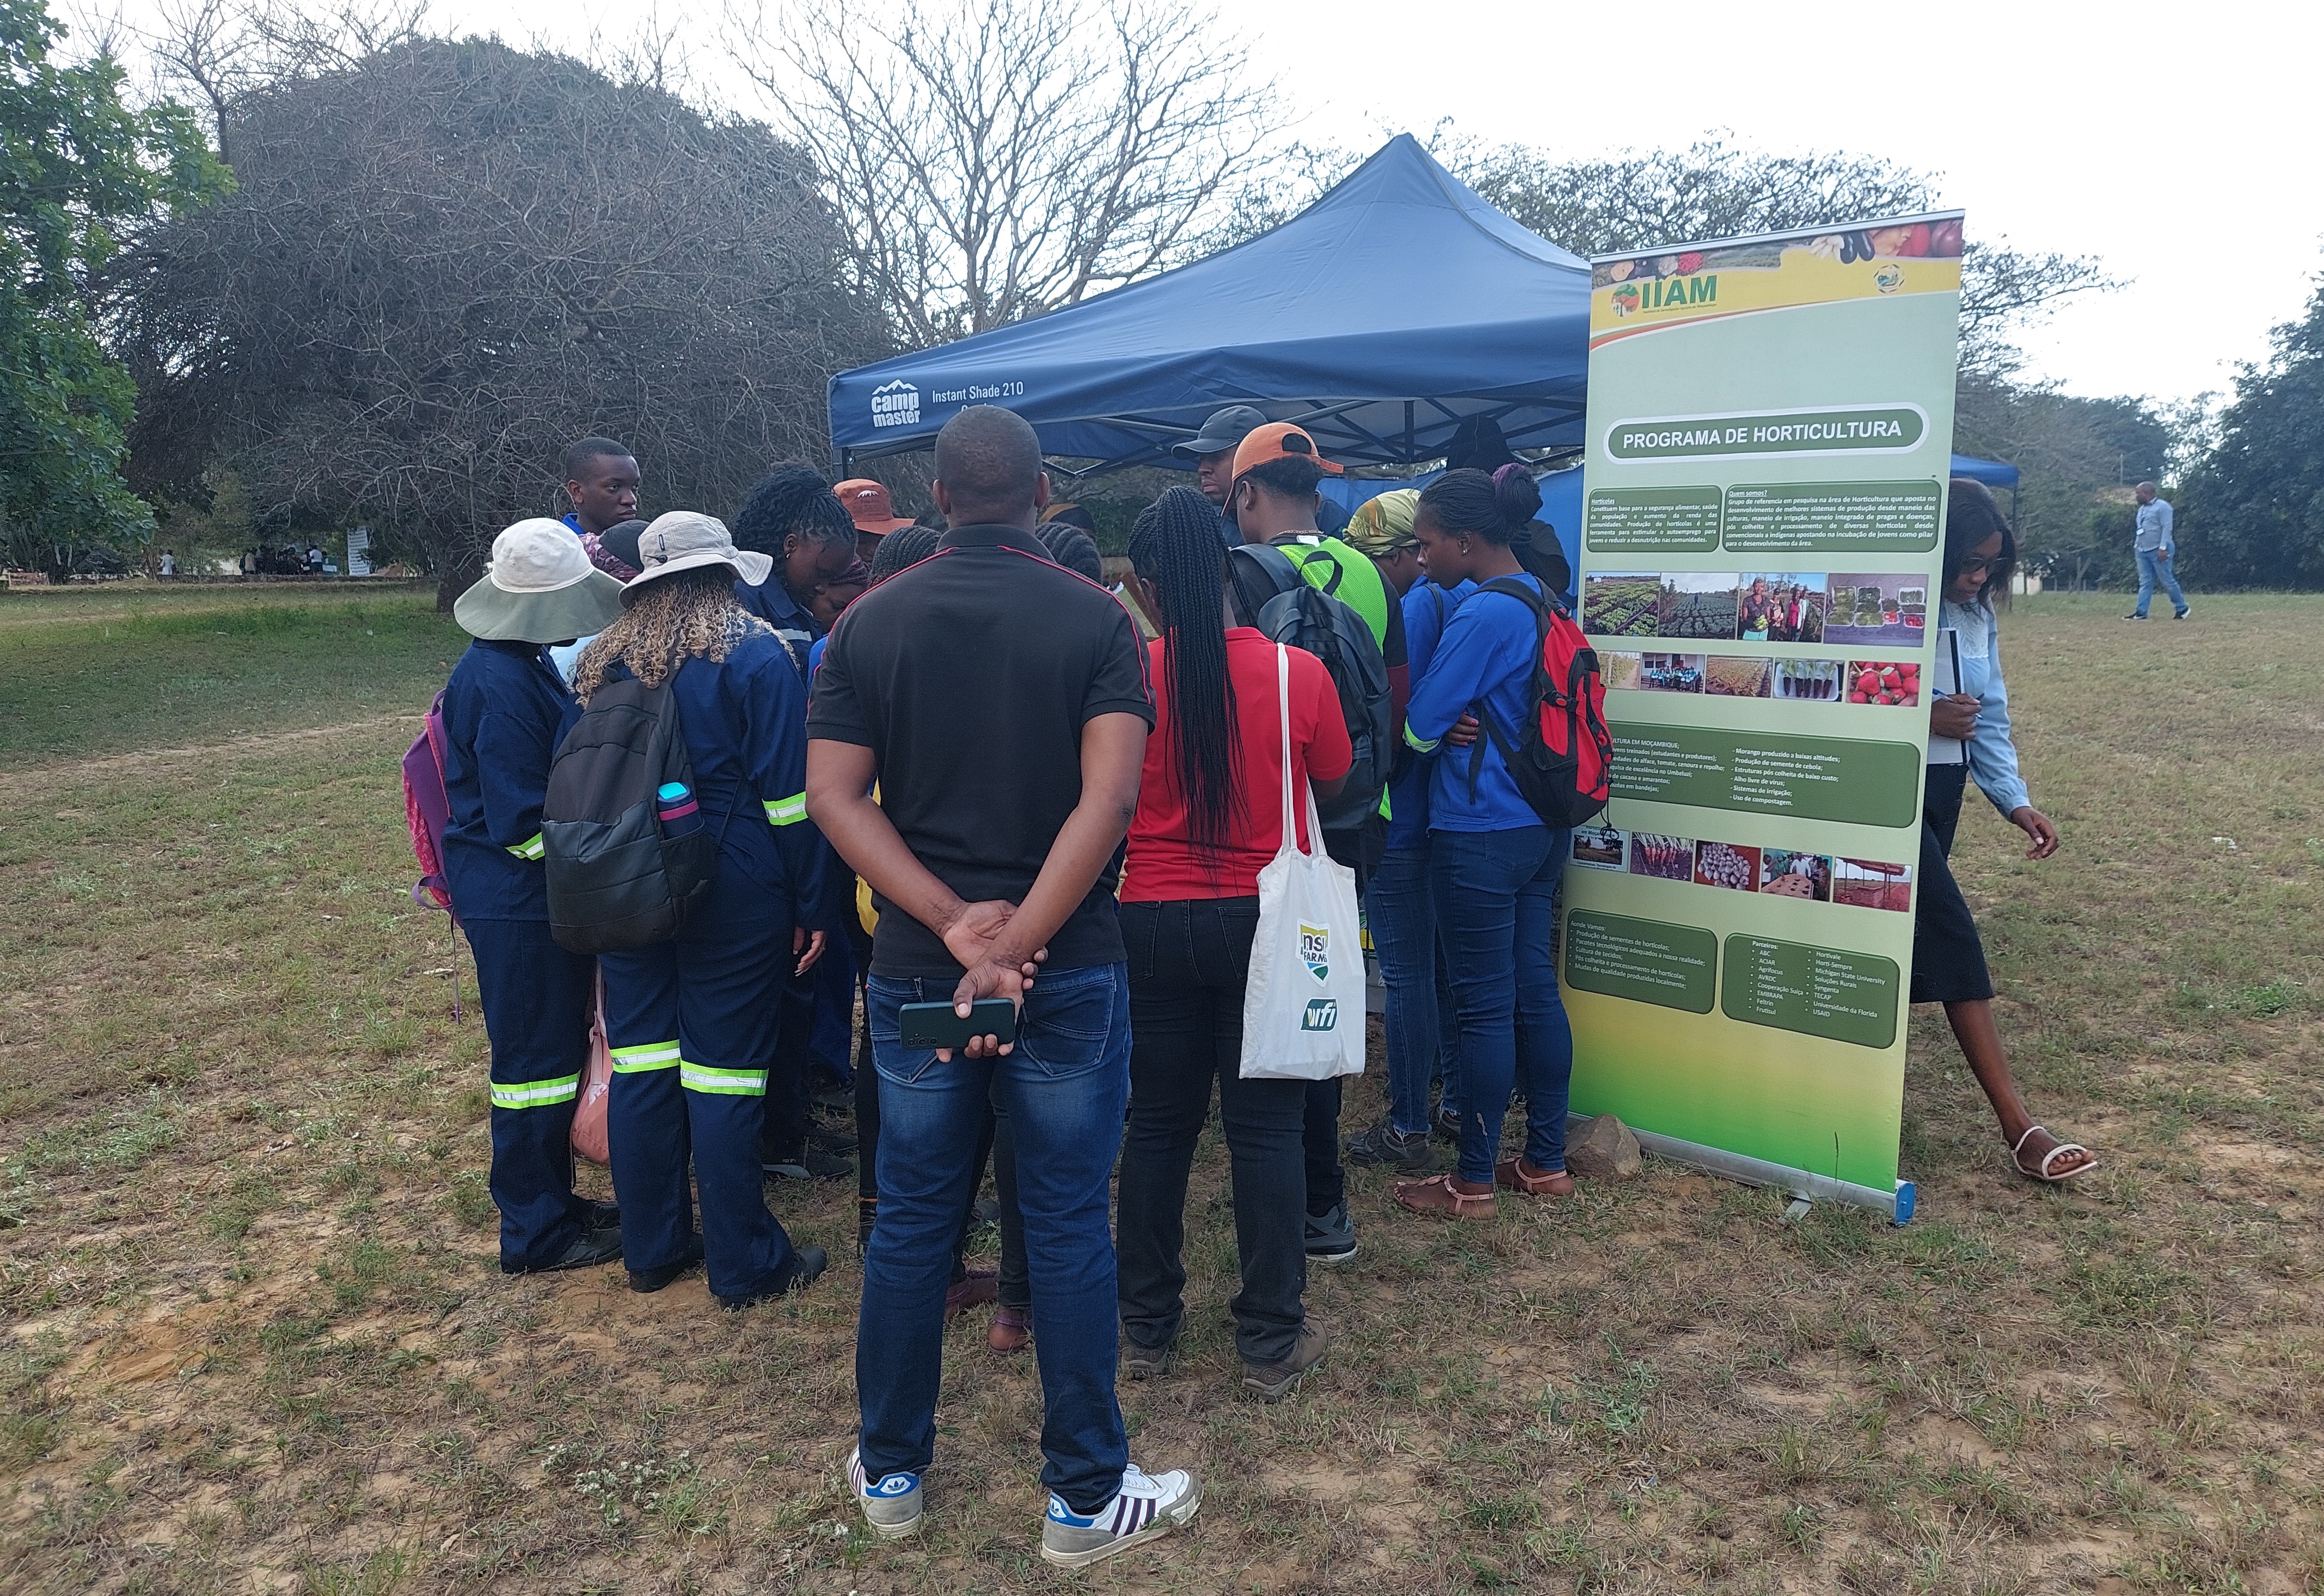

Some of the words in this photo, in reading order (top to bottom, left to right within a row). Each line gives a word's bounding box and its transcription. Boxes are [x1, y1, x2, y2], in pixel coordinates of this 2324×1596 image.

[1642, 275, 1717, 309] IIAM
[933, 388, 967, 403] Instant
[969, 384, 999, 399] Shade
[1003, 381, 1023, 396] 210
[872, 392, 919, 413] camp
[873, 410, 920, 427] master
[1623, 430, 1721, 448] PROGRAMA
[1725, 427, 1748, 444] DE
[1753, 420, 1902, 442] HORTICULTURA
[1758, 974, 1776, 982] AVRDC
[1857, 975, 1886, 986] University
[1757, 990, 1783, 1000] EMBRAPA
